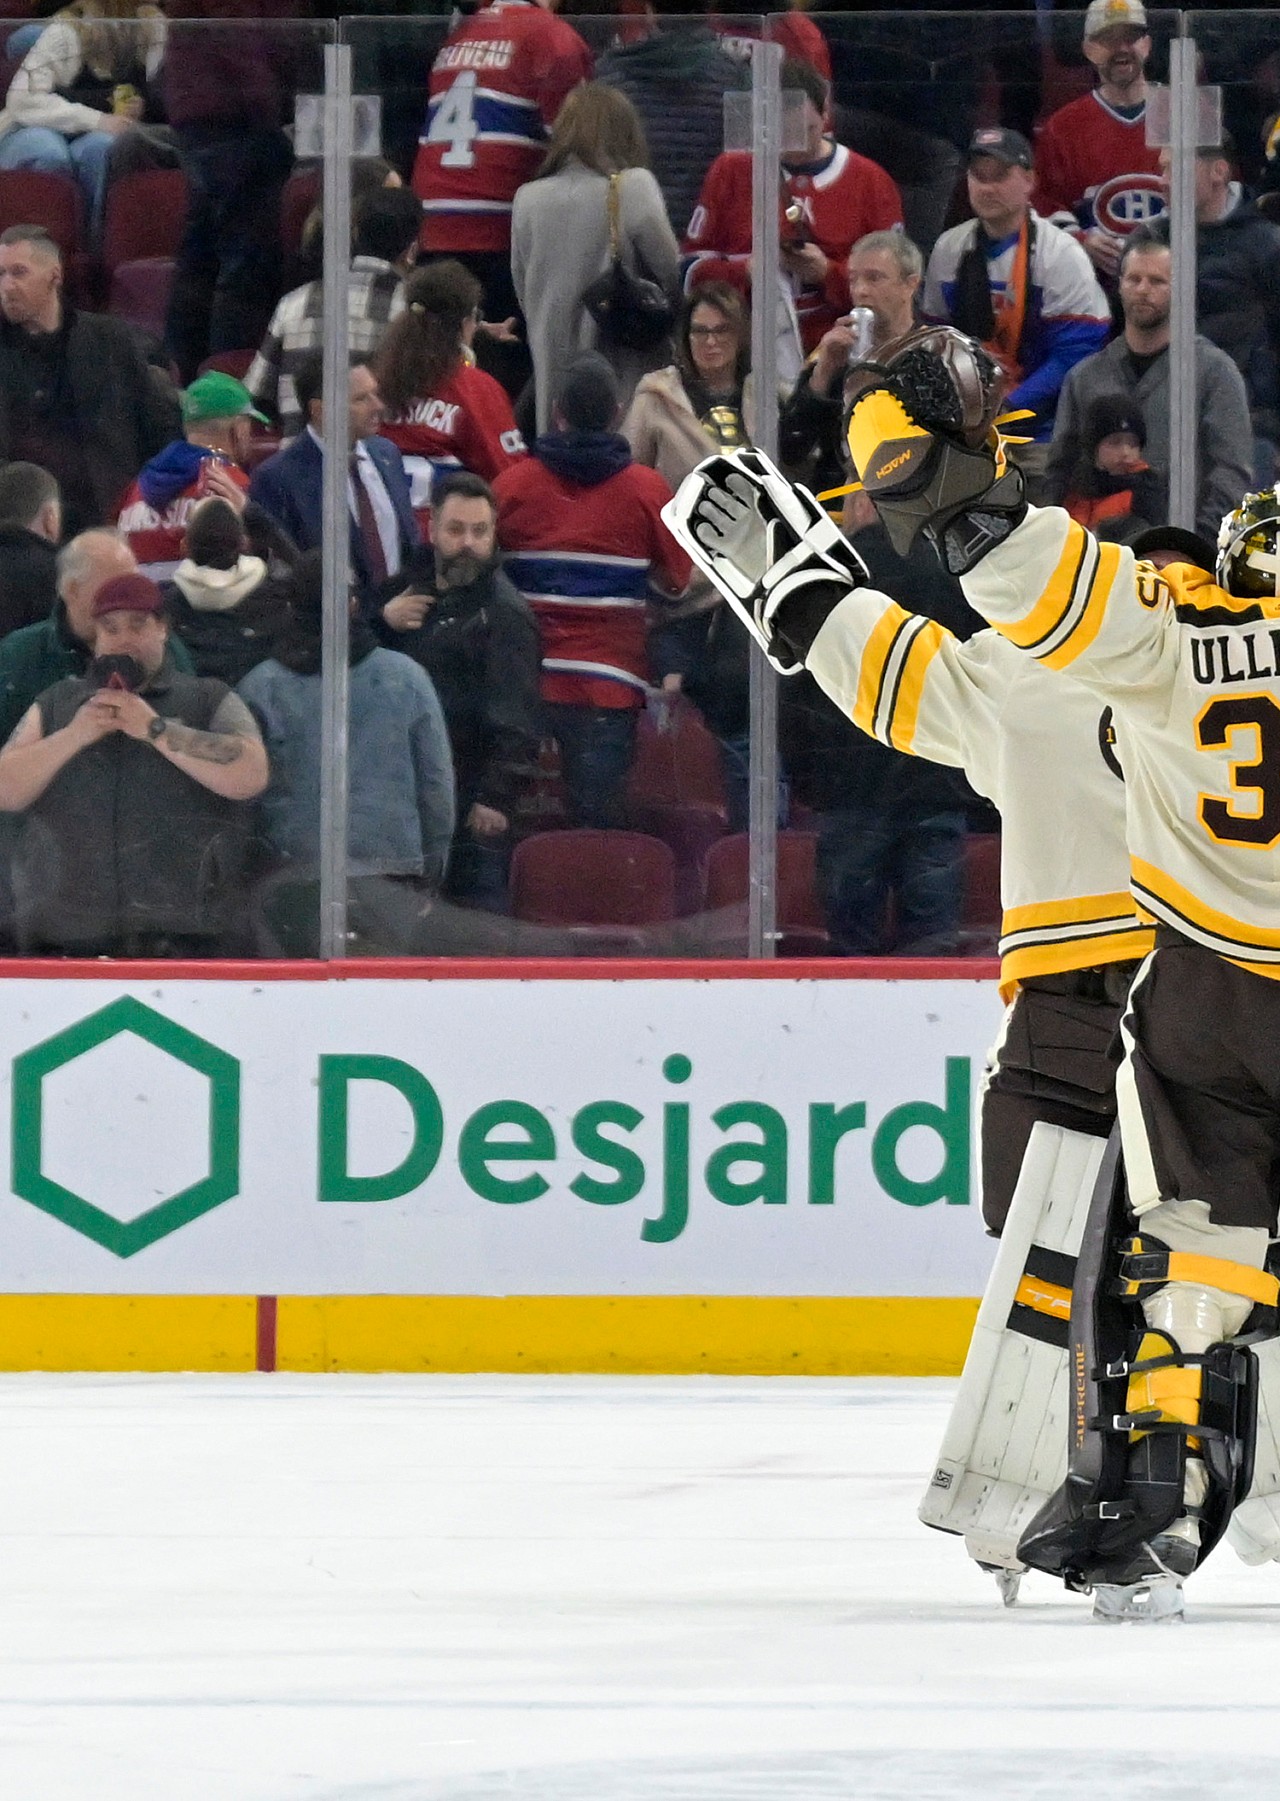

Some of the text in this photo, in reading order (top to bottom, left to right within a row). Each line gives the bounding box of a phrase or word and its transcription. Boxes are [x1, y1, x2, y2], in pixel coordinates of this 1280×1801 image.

[427, 69, 478, 168] 4
[875, 448, 913, 480] MACH
[319, 1053, 972, 1243] Desjard
[1075, 1342, 1086, 1449] SUPREME
